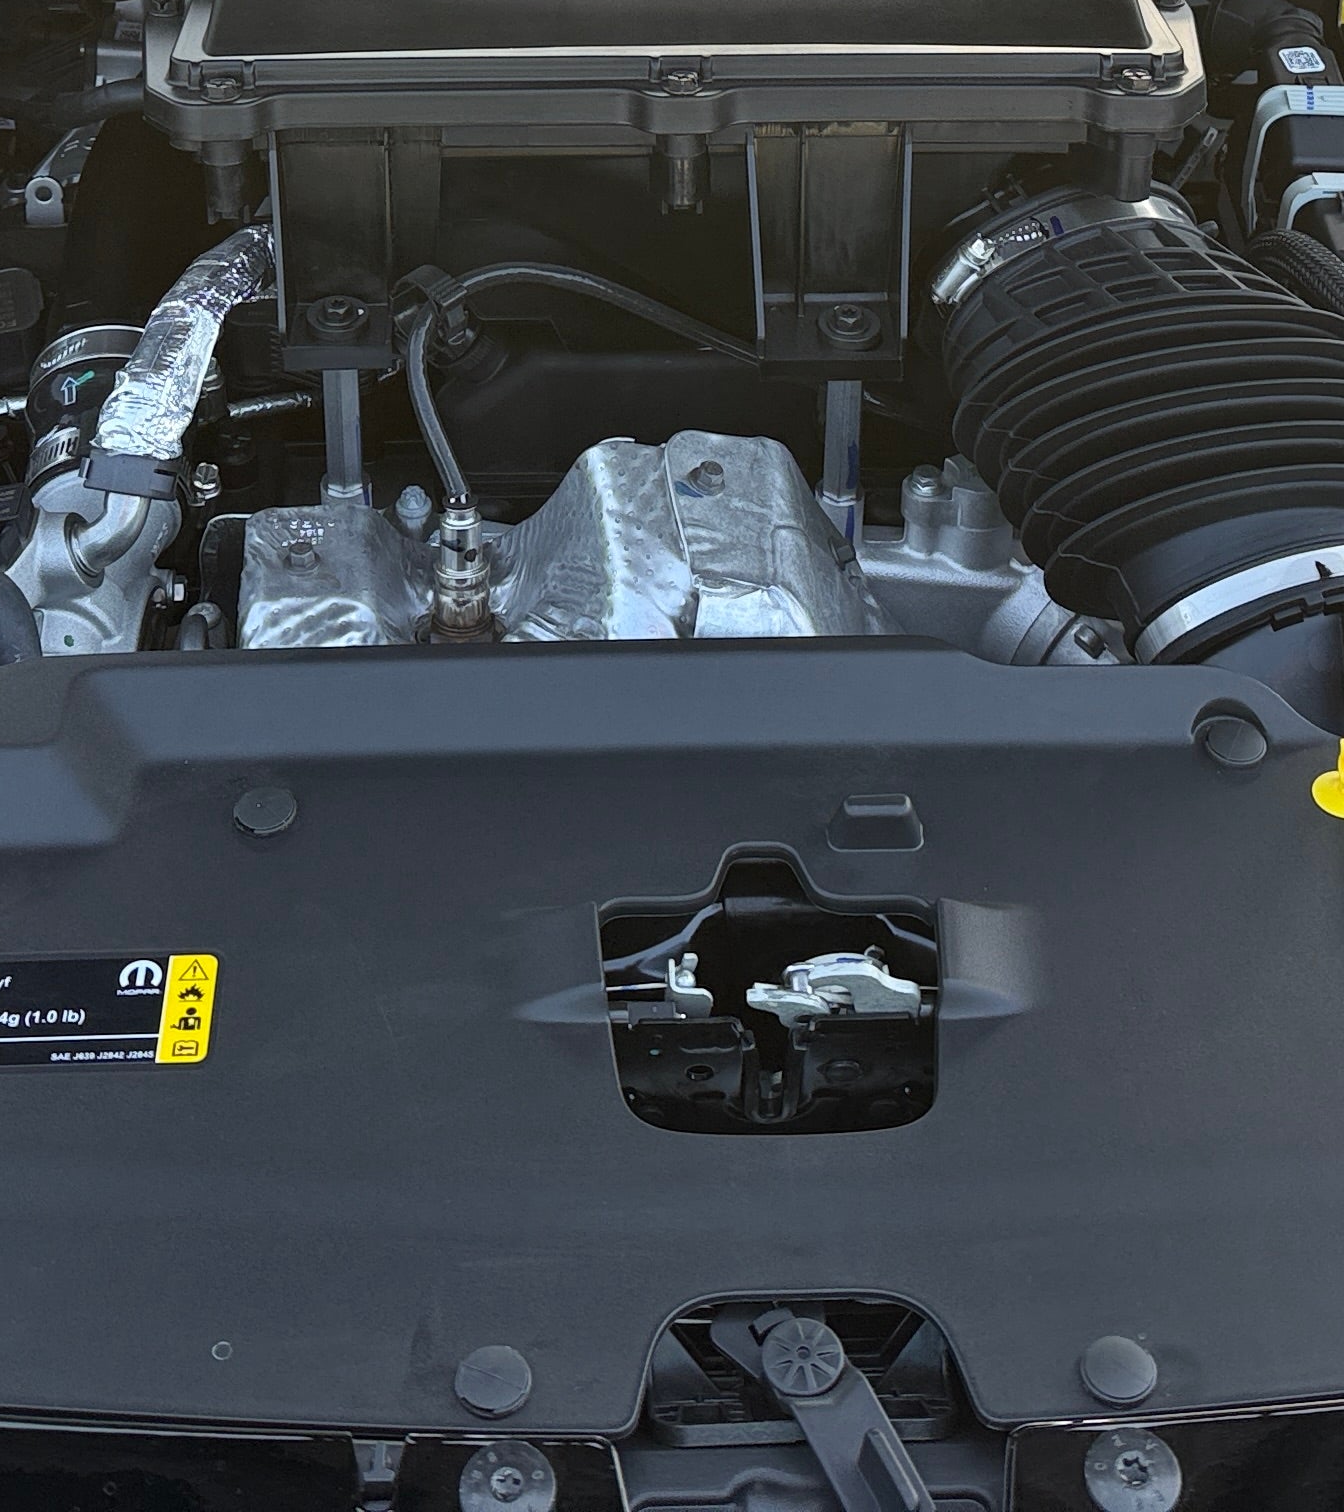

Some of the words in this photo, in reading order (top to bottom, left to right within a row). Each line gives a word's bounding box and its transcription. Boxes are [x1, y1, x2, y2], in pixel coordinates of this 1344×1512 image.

[116, 988, 160, 996] MOPAR
[24, 1009, 58, 1028] (1.0
[62, 1008, 86, 1027] lb)
[50, 1052, 71, 1061] SAE
